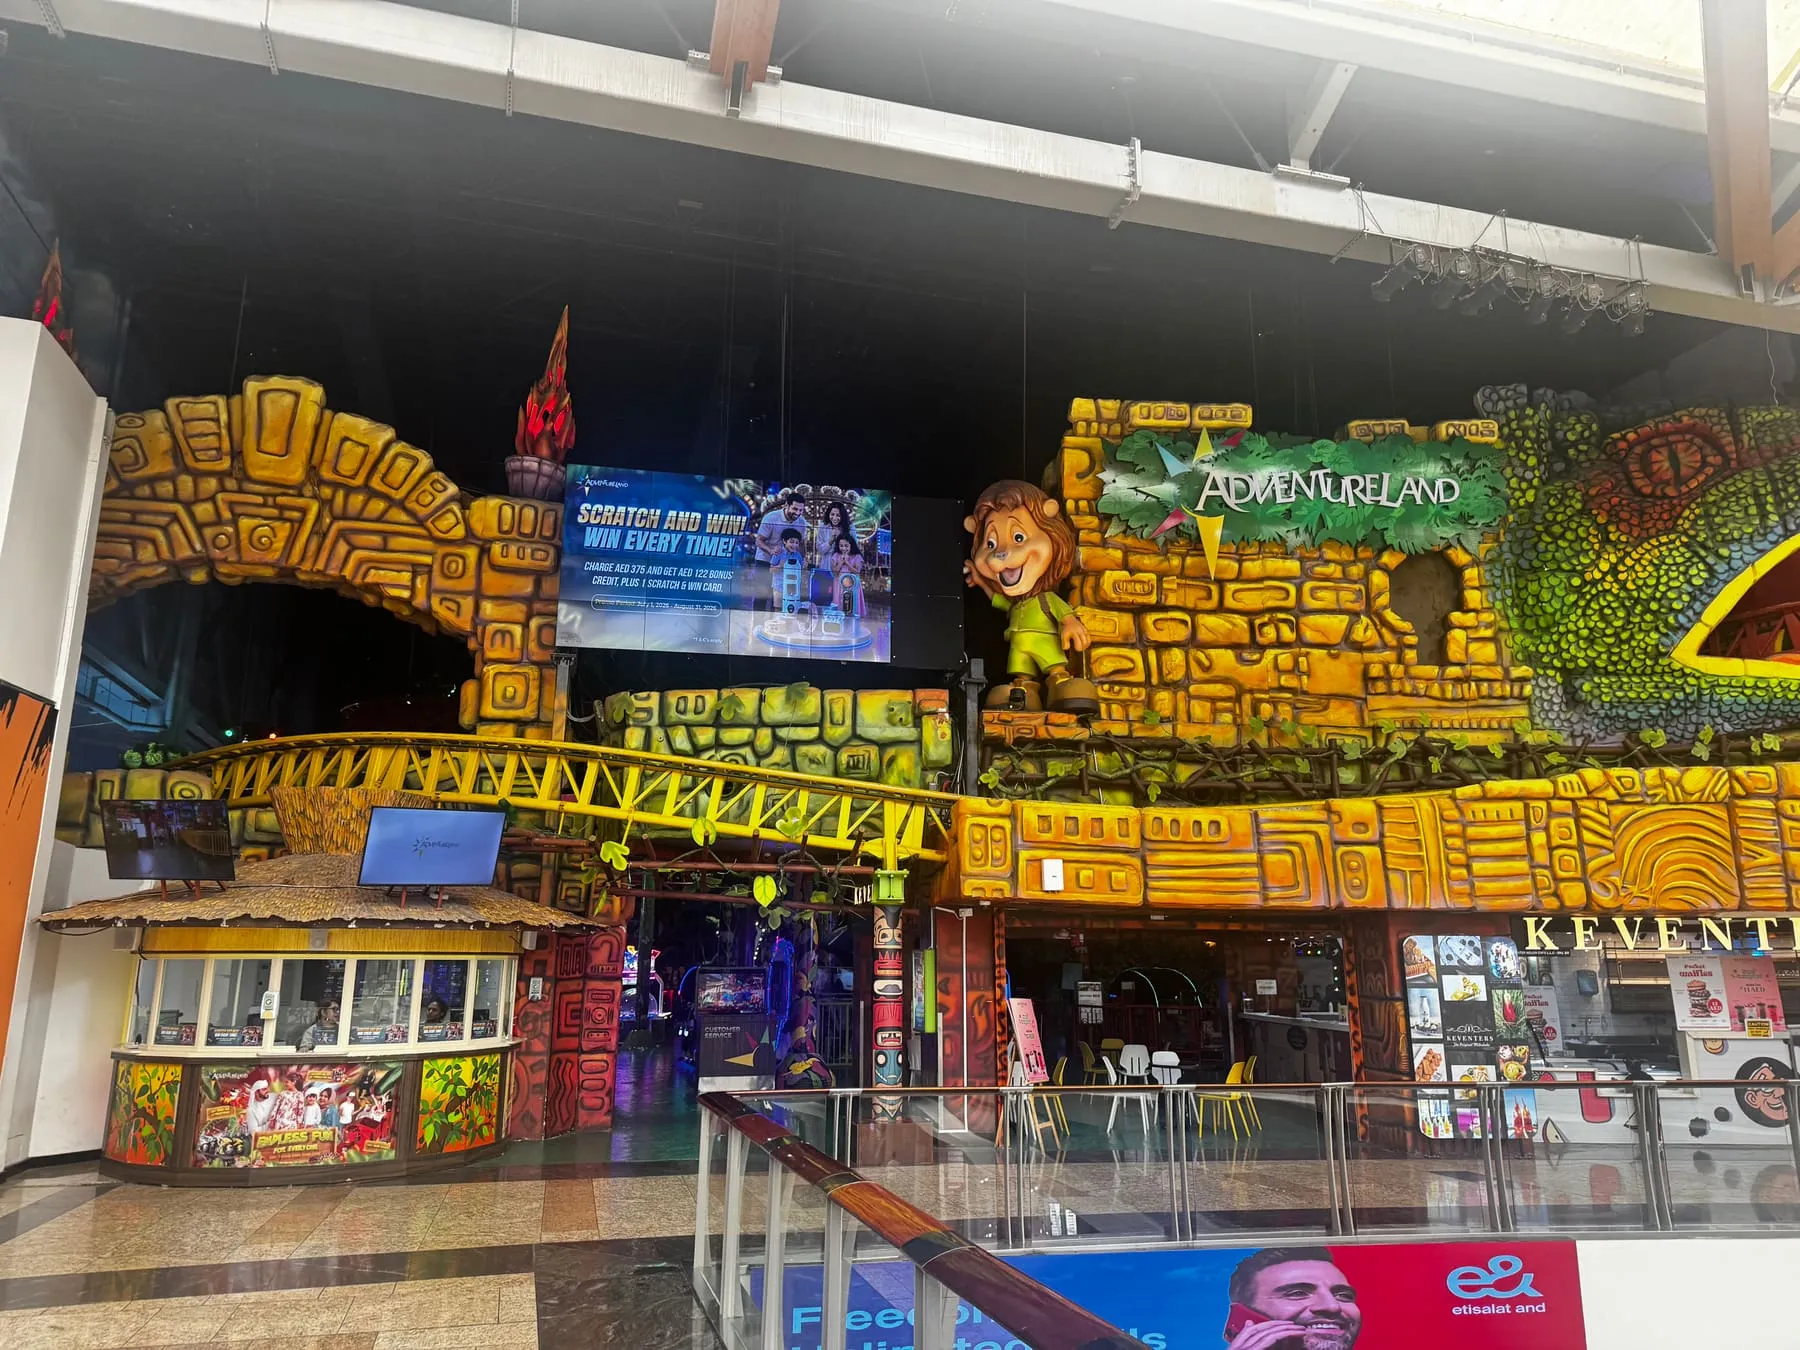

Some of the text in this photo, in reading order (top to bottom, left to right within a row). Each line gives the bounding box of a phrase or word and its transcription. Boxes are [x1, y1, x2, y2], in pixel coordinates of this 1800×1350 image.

[1195, 468, 1460, 512] ADVENTURELAND
[577, 503, 748, 535] SCRATCH AND WIN!
[584, 527, 736, 557] WIN EVERY TIME!
[584, 561, 734, 580] CHARGE AED 375 AND GET AED 122 BONUS
[620, 577, 640, 587] PLUS
[641, 578, 646, 588] 1
[648, 579, 680, 590] SCRATCH
[681, 580, 686, 590] &
[688, 581, 701, 591] WIN
[702, 582, 723, 592] CARD.
[311, 1130, 334, 1143] FUN
[1452, 1302, 1546, 1315] etisalat and
